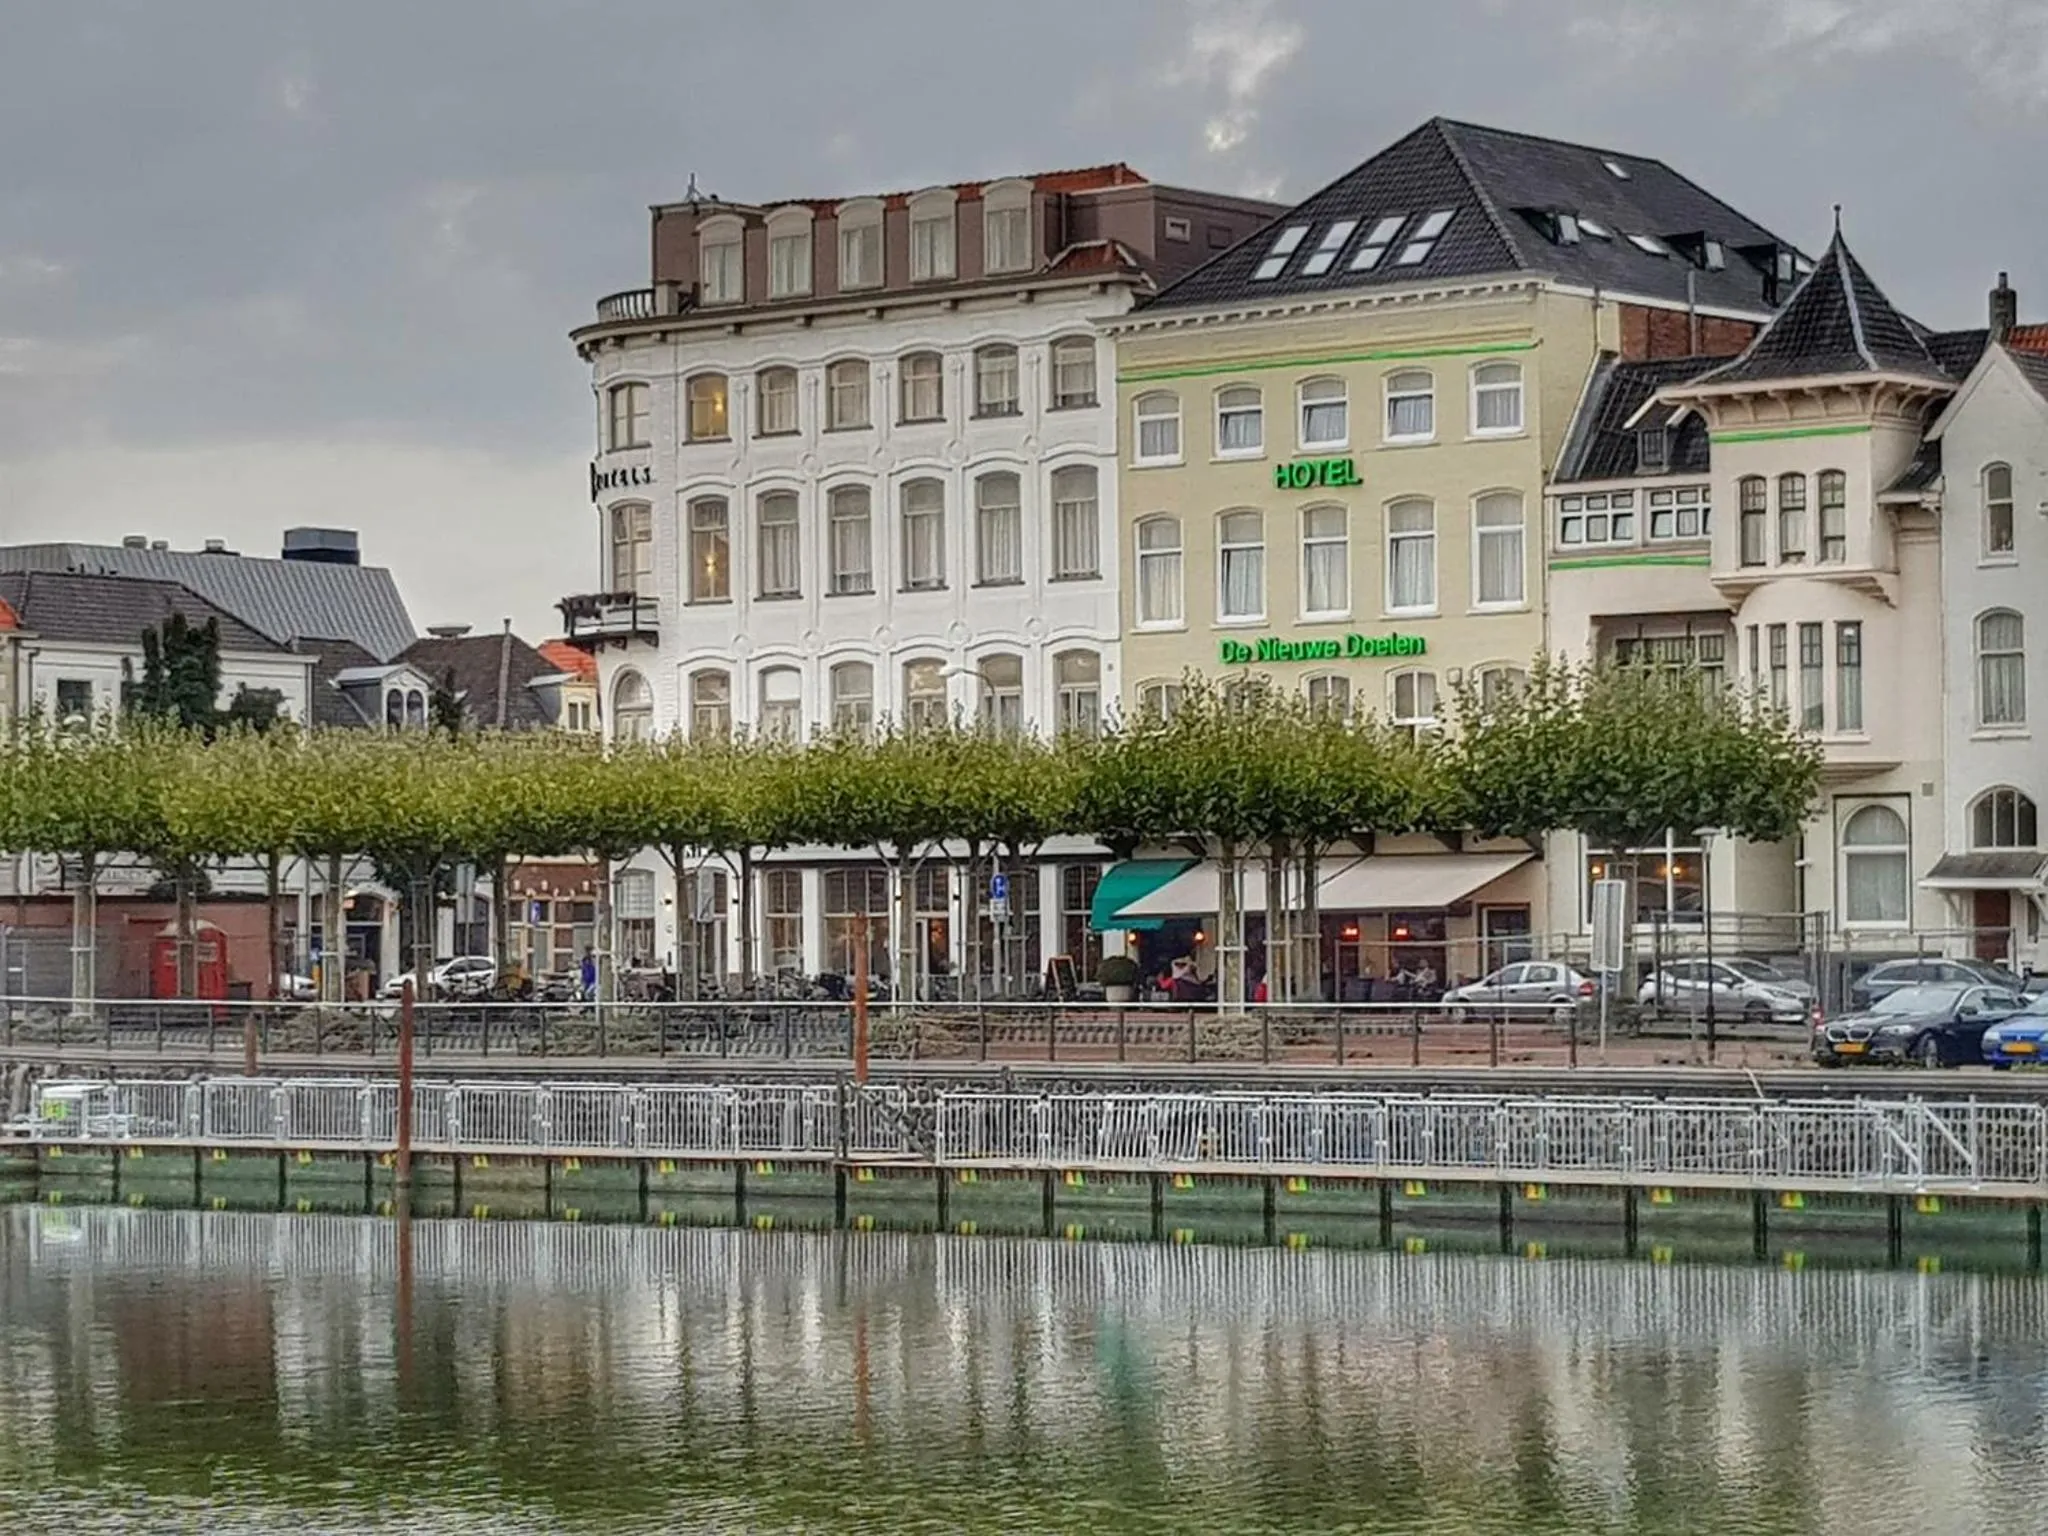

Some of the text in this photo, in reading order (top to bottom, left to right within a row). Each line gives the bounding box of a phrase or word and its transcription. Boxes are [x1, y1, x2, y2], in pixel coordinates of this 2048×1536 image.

[1275, 459, 1363, 488] HOTEL
[1220, 632, 1427, 664] De Nieuwe Doelen
